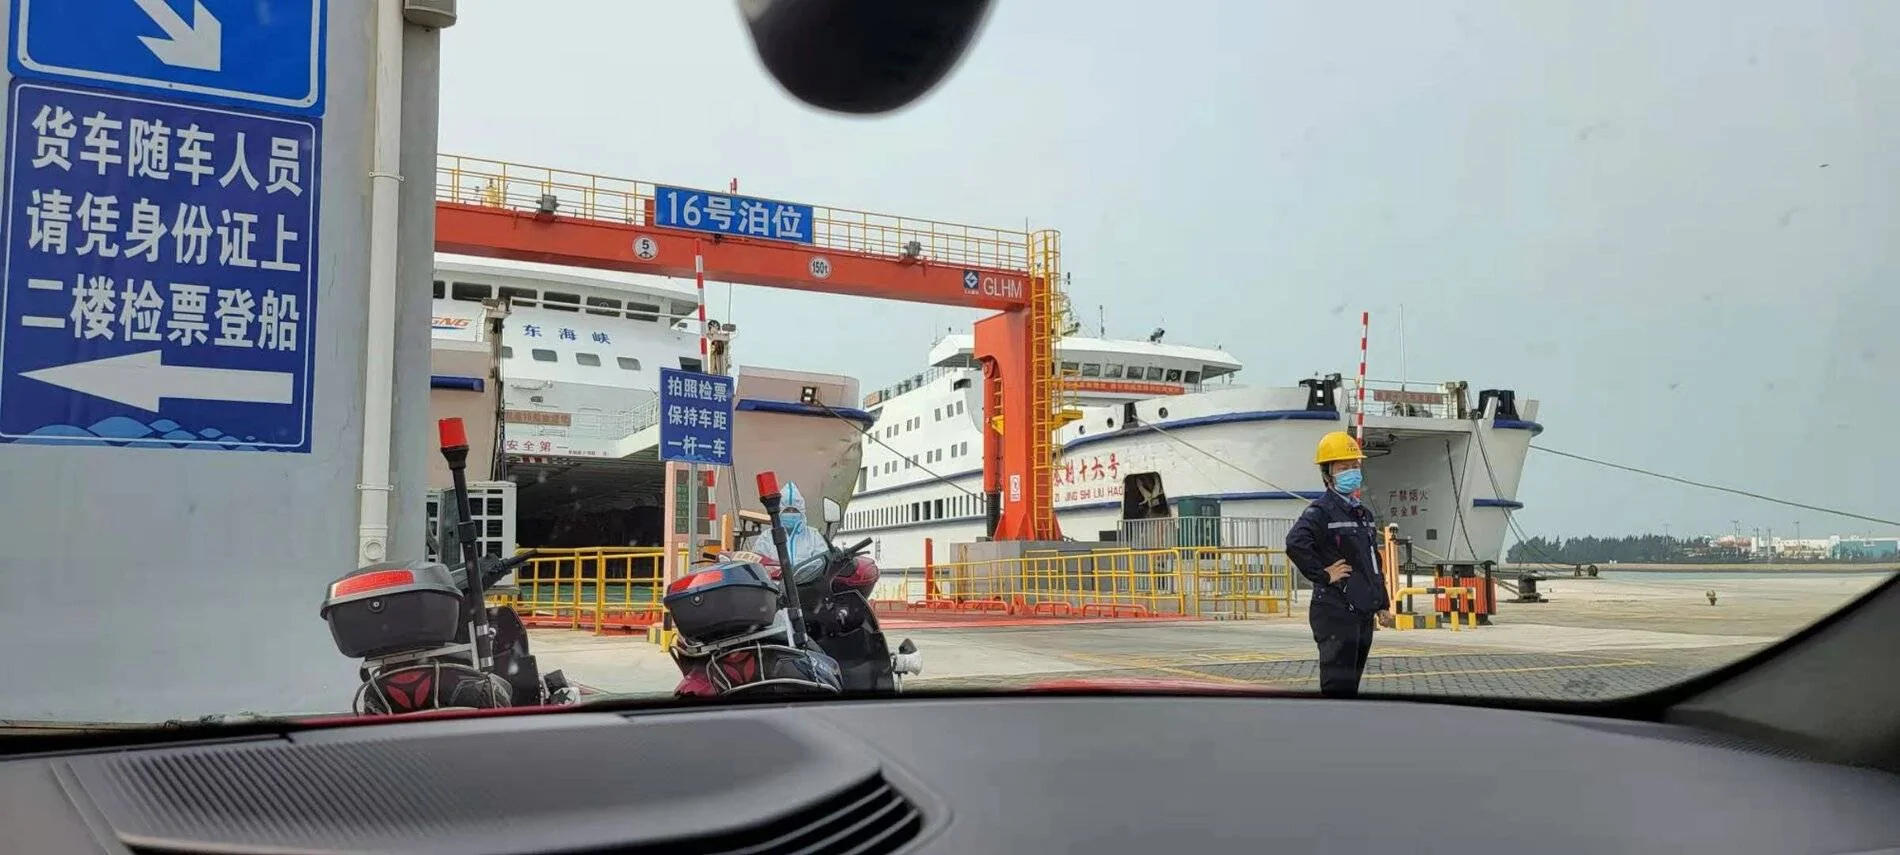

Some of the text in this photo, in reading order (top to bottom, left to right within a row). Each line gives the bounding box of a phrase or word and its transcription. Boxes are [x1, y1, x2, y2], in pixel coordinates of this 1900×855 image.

[32, 104, 304, 197] 货车随车人员
[667, 191, 803, 239] 16号泊位
[26, 189, 301, 272] 请凭身份证上
[641, 239, 650, 250] 5
[983, 276, 1023, 299] GLHM
[21, 274, 300, 352] 二楼检票登船
[667, 376, 728, 403] 拍照检票
[667, 404, 728, 431] 保持车距
[506, 439, 569, 453] 安全第一
[667, 434, 727, 458] 一杆一车
[1094, 487, 1105, 498] LIU
